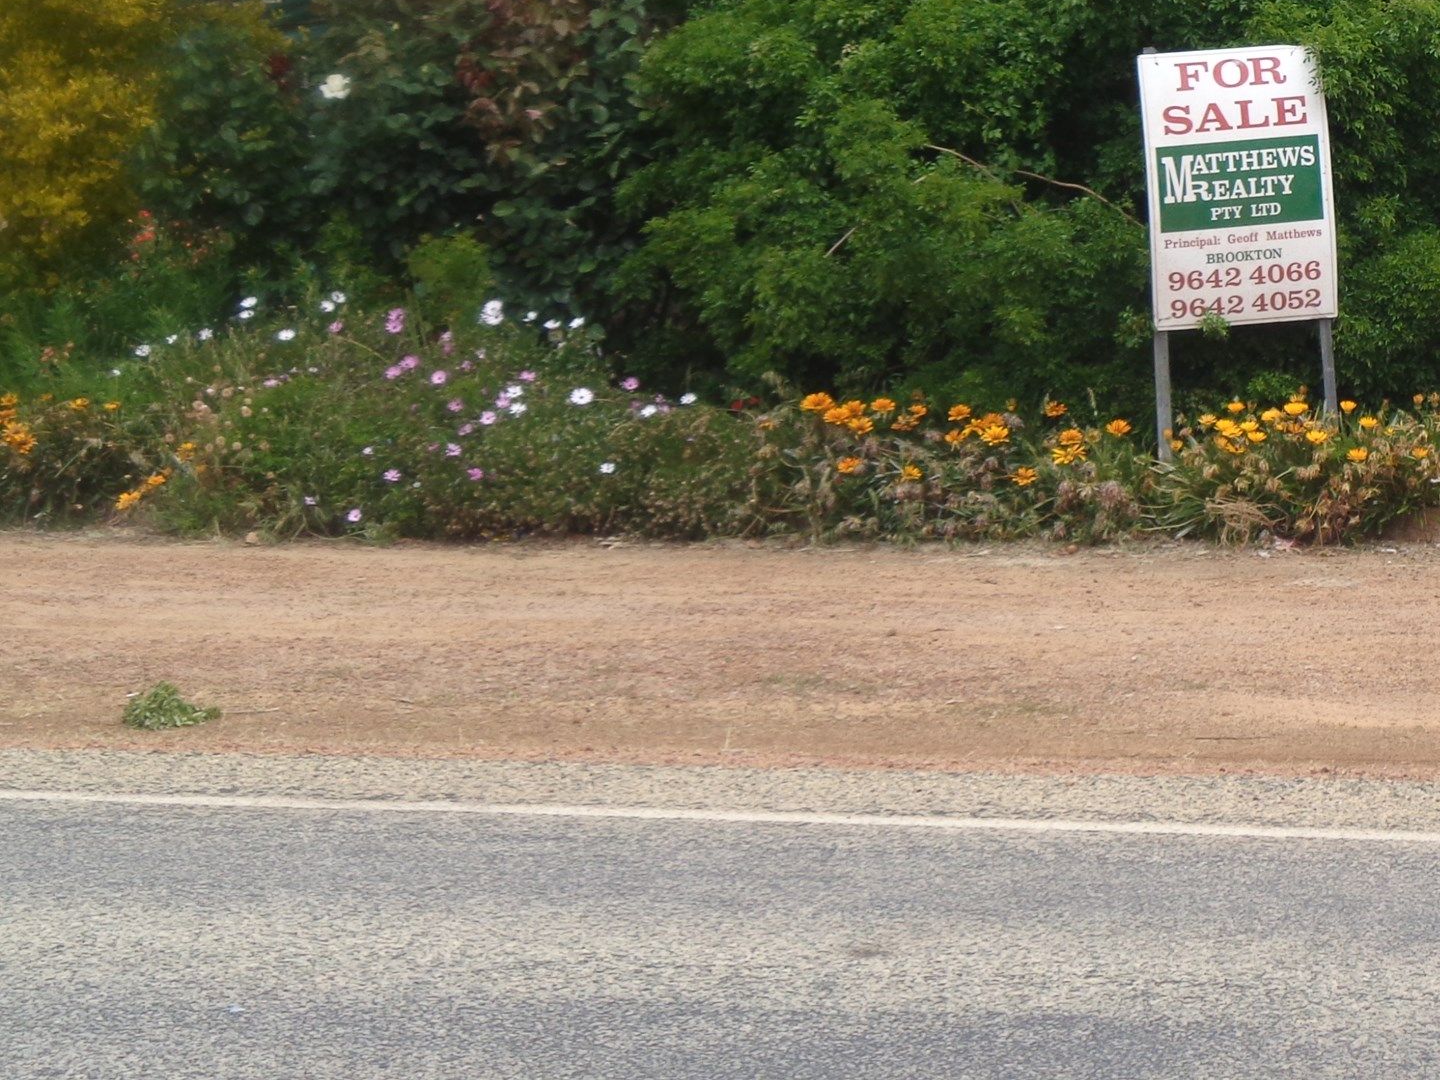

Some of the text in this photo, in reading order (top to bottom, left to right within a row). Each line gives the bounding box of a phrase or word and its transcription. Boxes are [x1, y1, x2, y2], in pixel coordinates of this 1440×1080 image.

[1174, 56, 1287, 92] FOR
[1162, 95, 1308, 136] SALE
[1161, 145, 1316, 204] MATTHEWS
[1191, 174, 1295, 202] REALTY
[1210, 202, 1282, 221] PTY LTD
[1164, 228, 1322, 249] Principal: Geoff Matthews
[1205, 248, 1283, 264] BROOKTON
[1168, 260, 1322, 291] 9642 4066
[1170, 288, 1322, 319] 9642 4052
